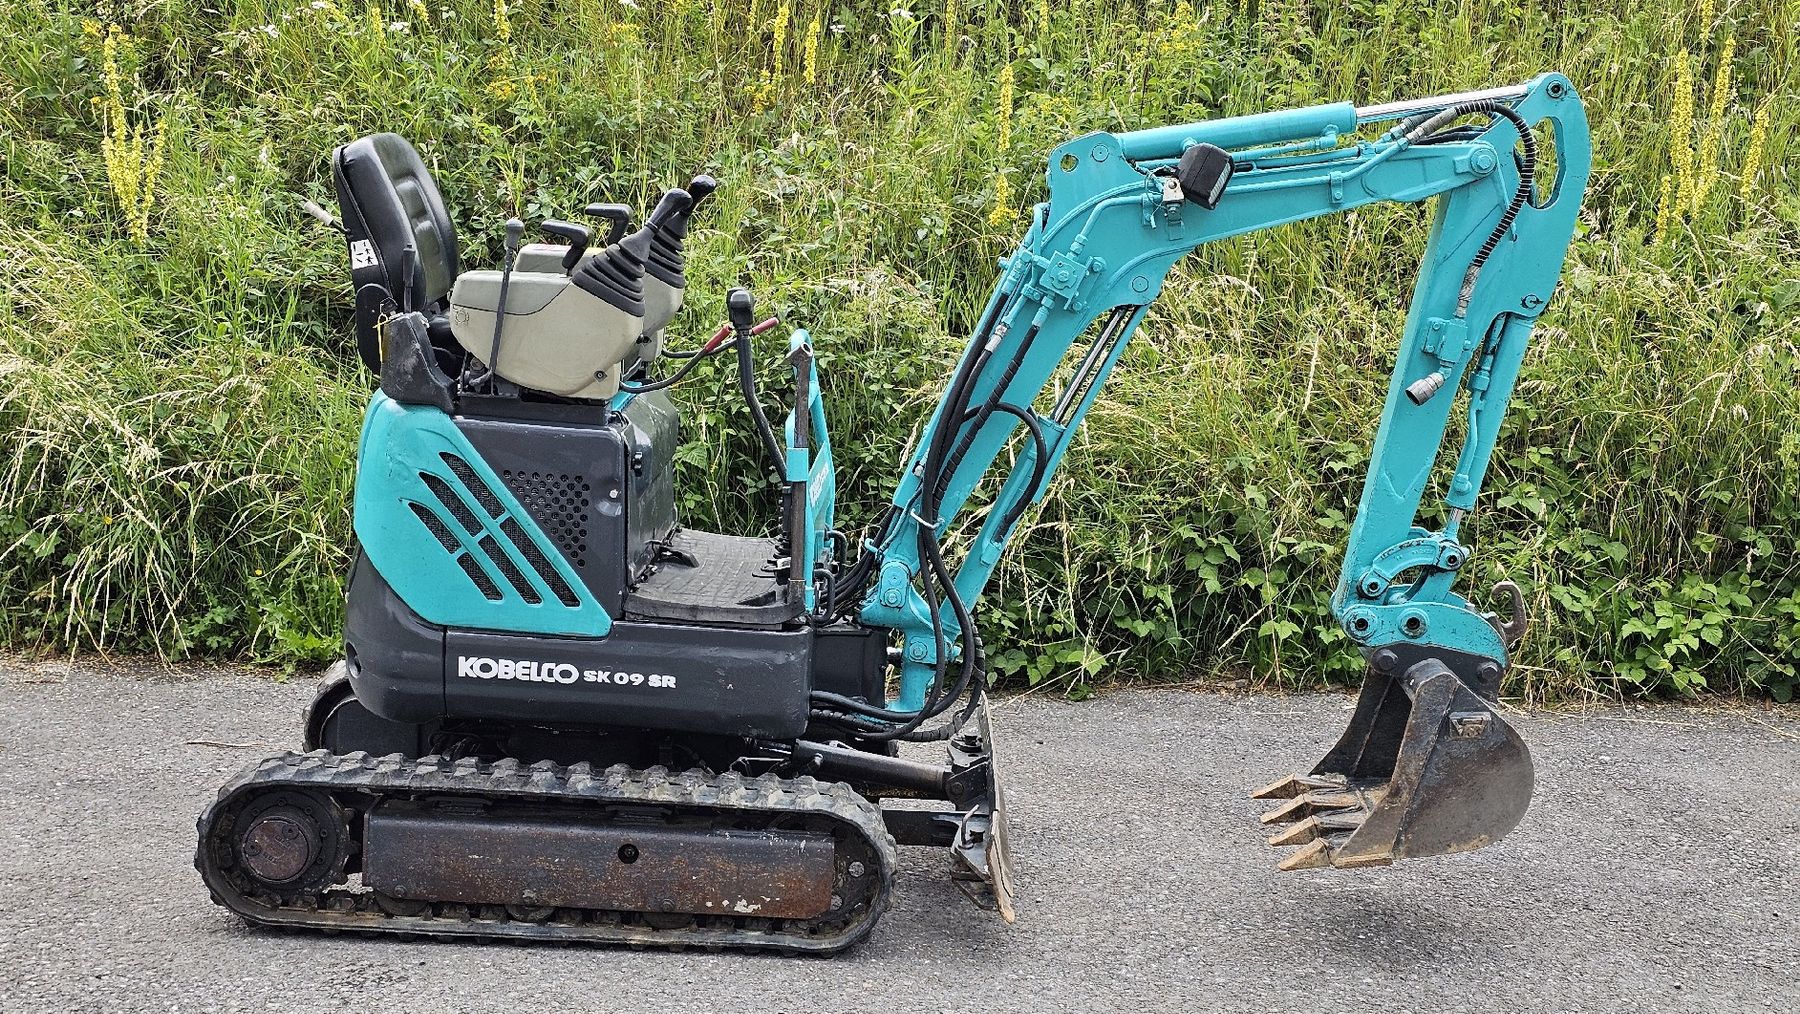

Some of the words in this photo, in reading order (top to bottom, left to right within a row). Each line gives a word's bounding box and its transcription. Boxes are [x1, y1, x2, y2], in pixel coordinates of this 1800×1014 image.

[458, 656, 580, 684] KOBELCO
[583, 670, 611, 684] SK
[613, 672, 645, 686] 09
[648, 674, 676, 689] SR
